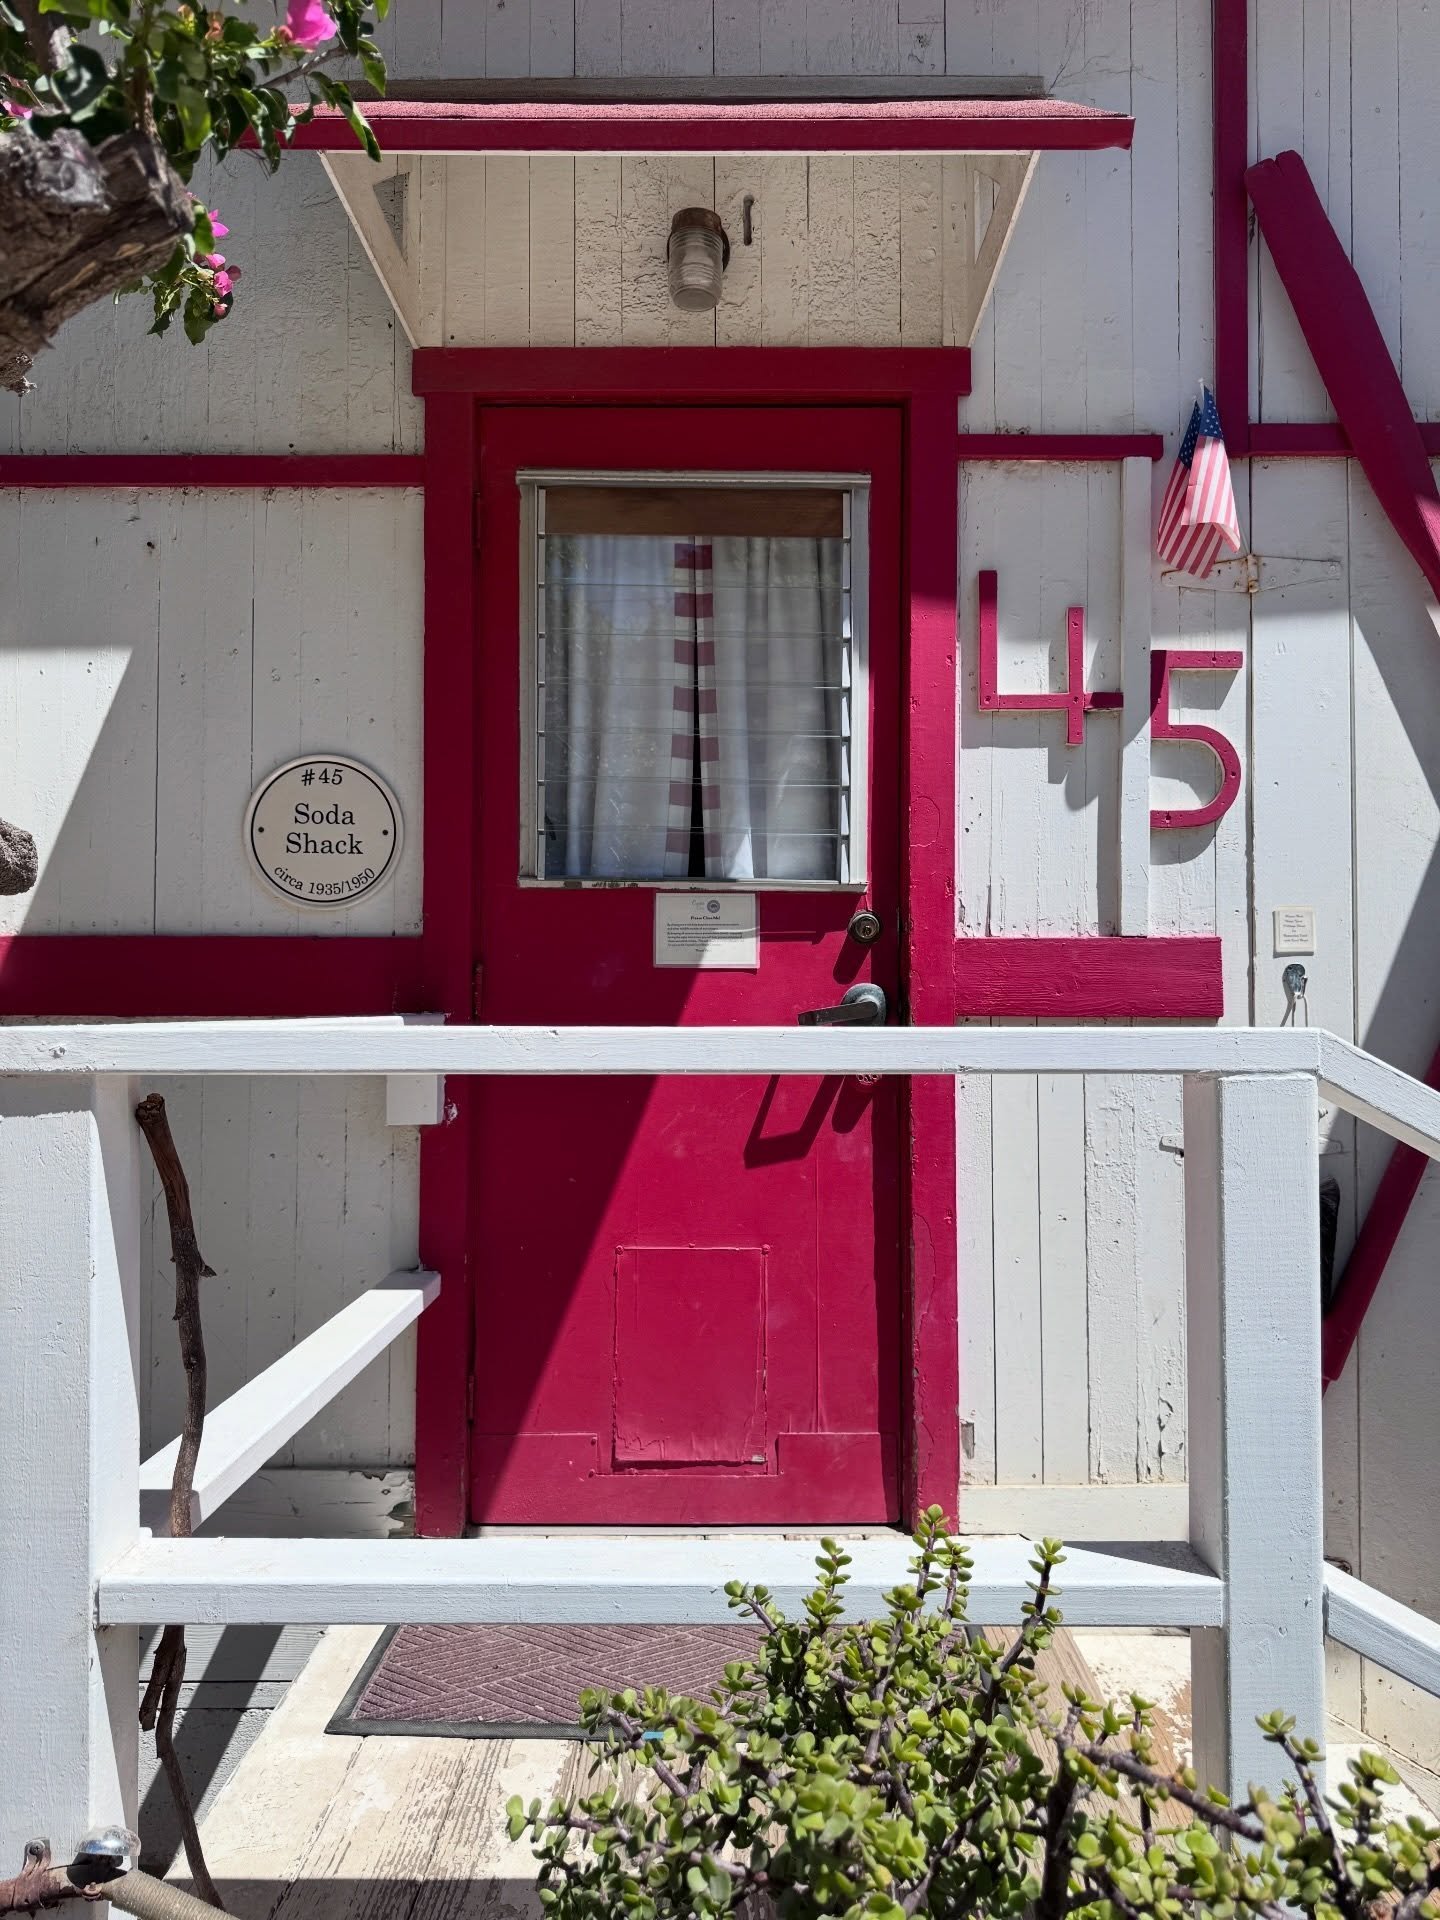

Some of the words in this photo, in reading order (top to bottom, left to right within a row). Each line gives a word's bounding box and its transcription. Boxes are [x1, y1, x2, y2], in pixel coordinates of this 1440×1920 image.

[301, 768, 344, 787] #45
[294, 802, 356, 825] Soda
[285, 831, 364, 855] Shack
[273, 866, 304, 891] circa
[307, 867, 375, 895] 1935/1950
